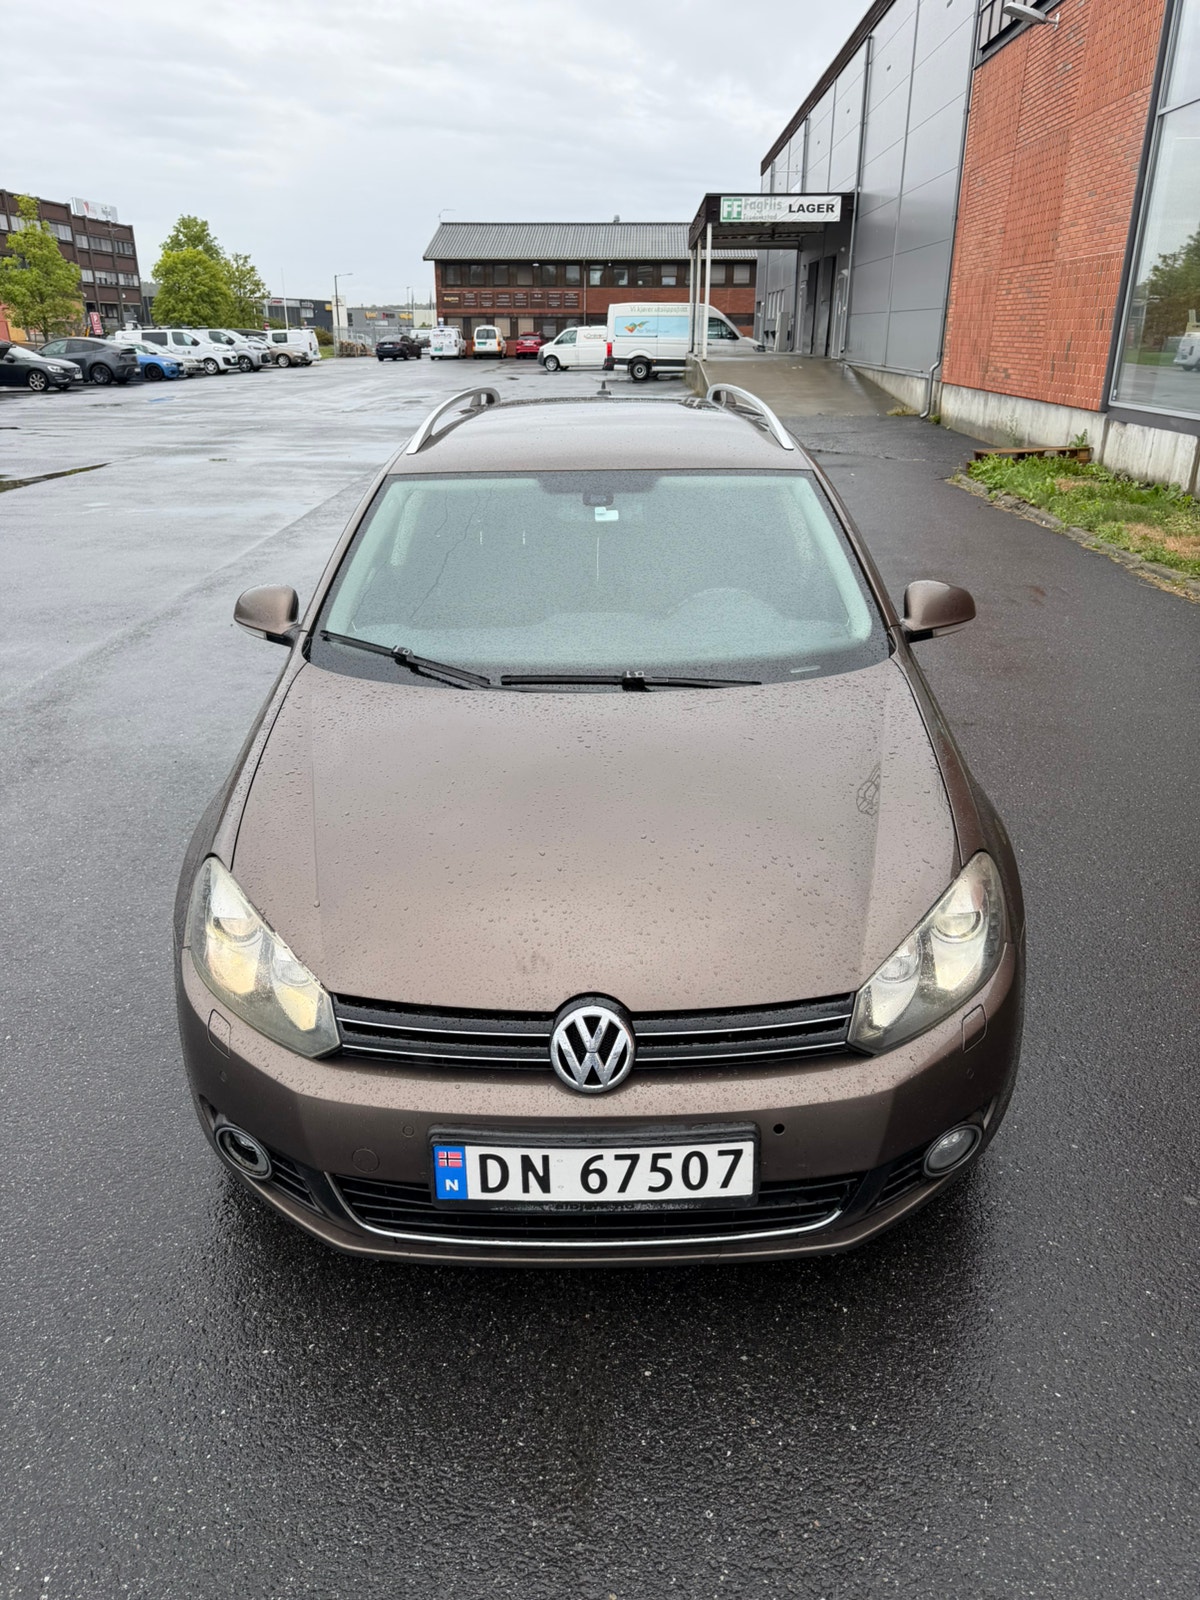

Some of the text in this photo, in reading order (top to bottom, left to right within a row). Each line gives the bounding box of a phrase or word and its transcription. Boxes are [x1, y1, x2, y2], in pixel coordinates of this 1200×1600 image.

[788, 203, 835, 213] LAGER
[554, 1009, 631, 1090] VW
[445, 1178, 459, 1192] N
[478, 1148, 744, 1194] DN 67507
